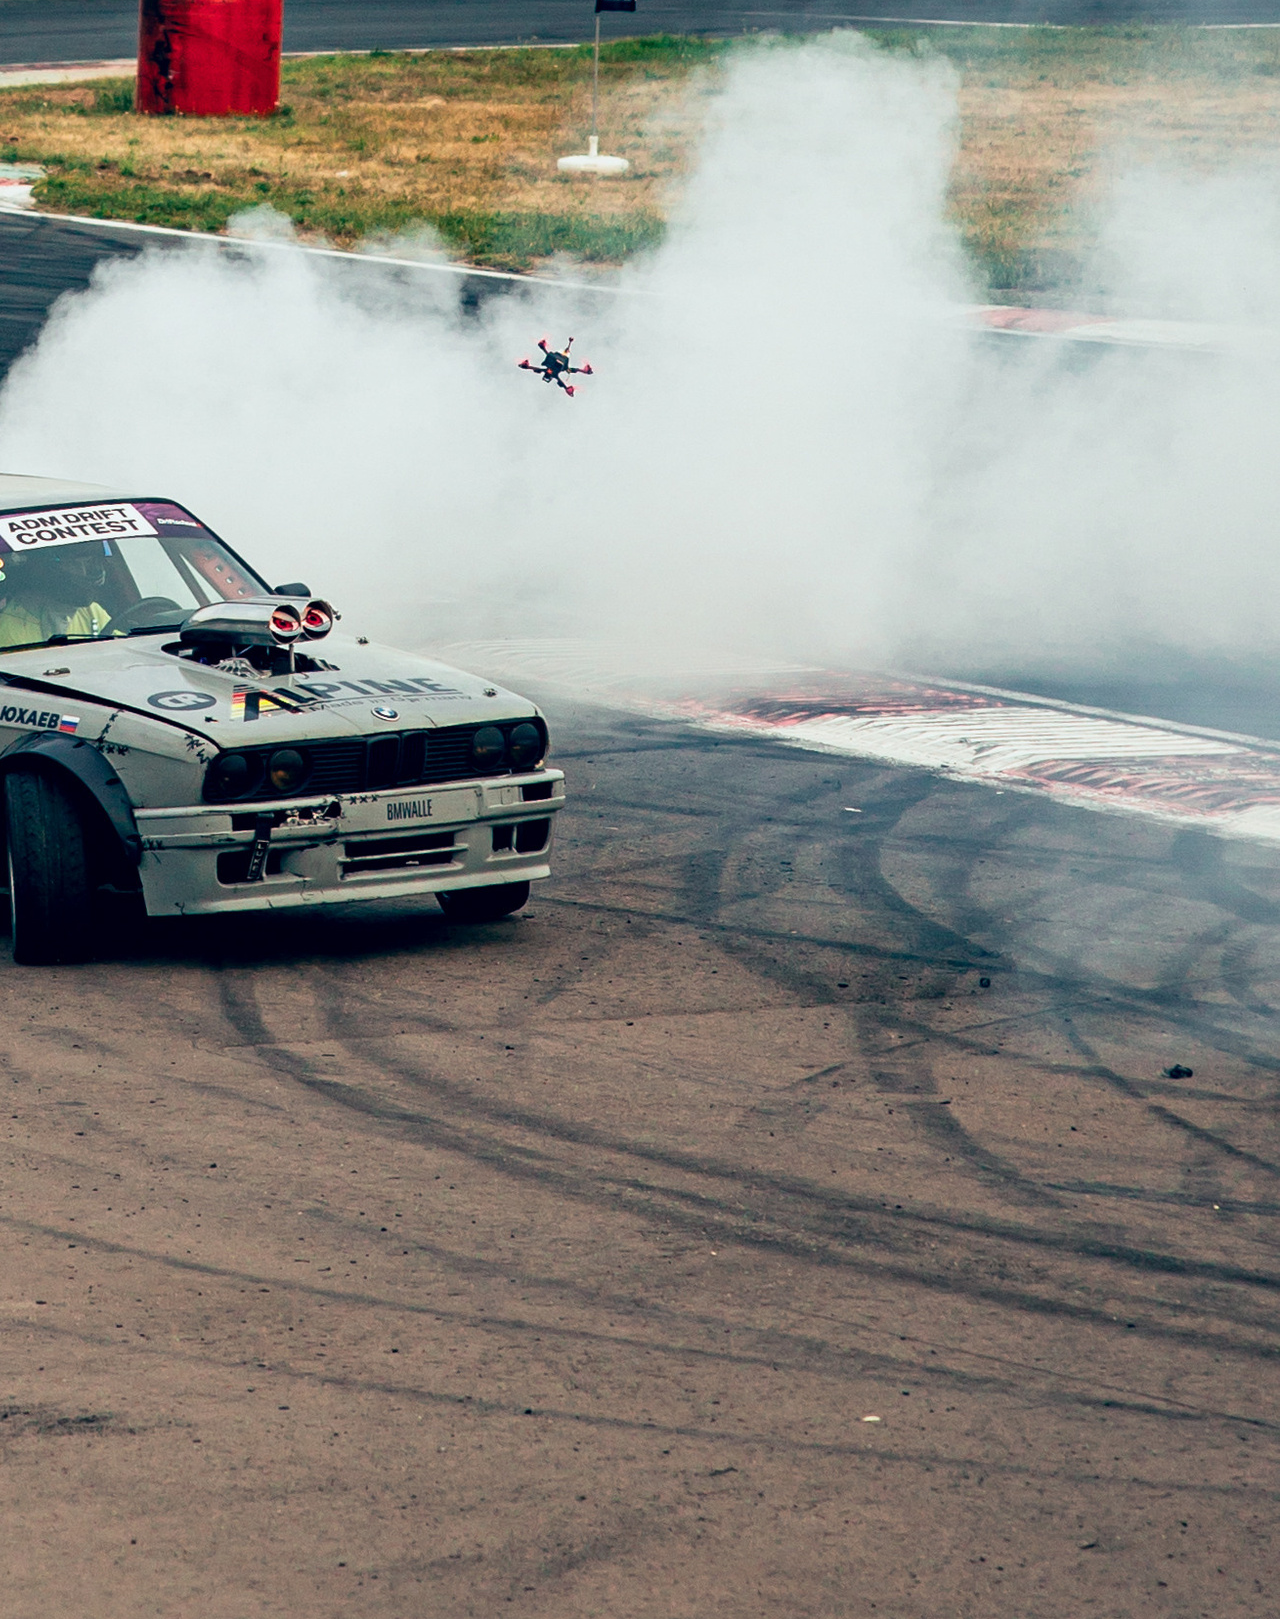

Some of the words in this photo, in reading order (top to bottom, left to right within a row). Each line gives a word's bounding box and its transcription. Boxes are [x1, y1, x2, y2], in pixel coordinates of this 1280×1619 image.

[8, 515, 59, 533] ADM
[62, 508, 128, 525] DRIFT
[16, 519, 140, 545] CONTEST
[240, 677, 458, 722] ALPINE
[309, 699, 363, 712] Made
[387, 798, 433, 821] BMWALLE
